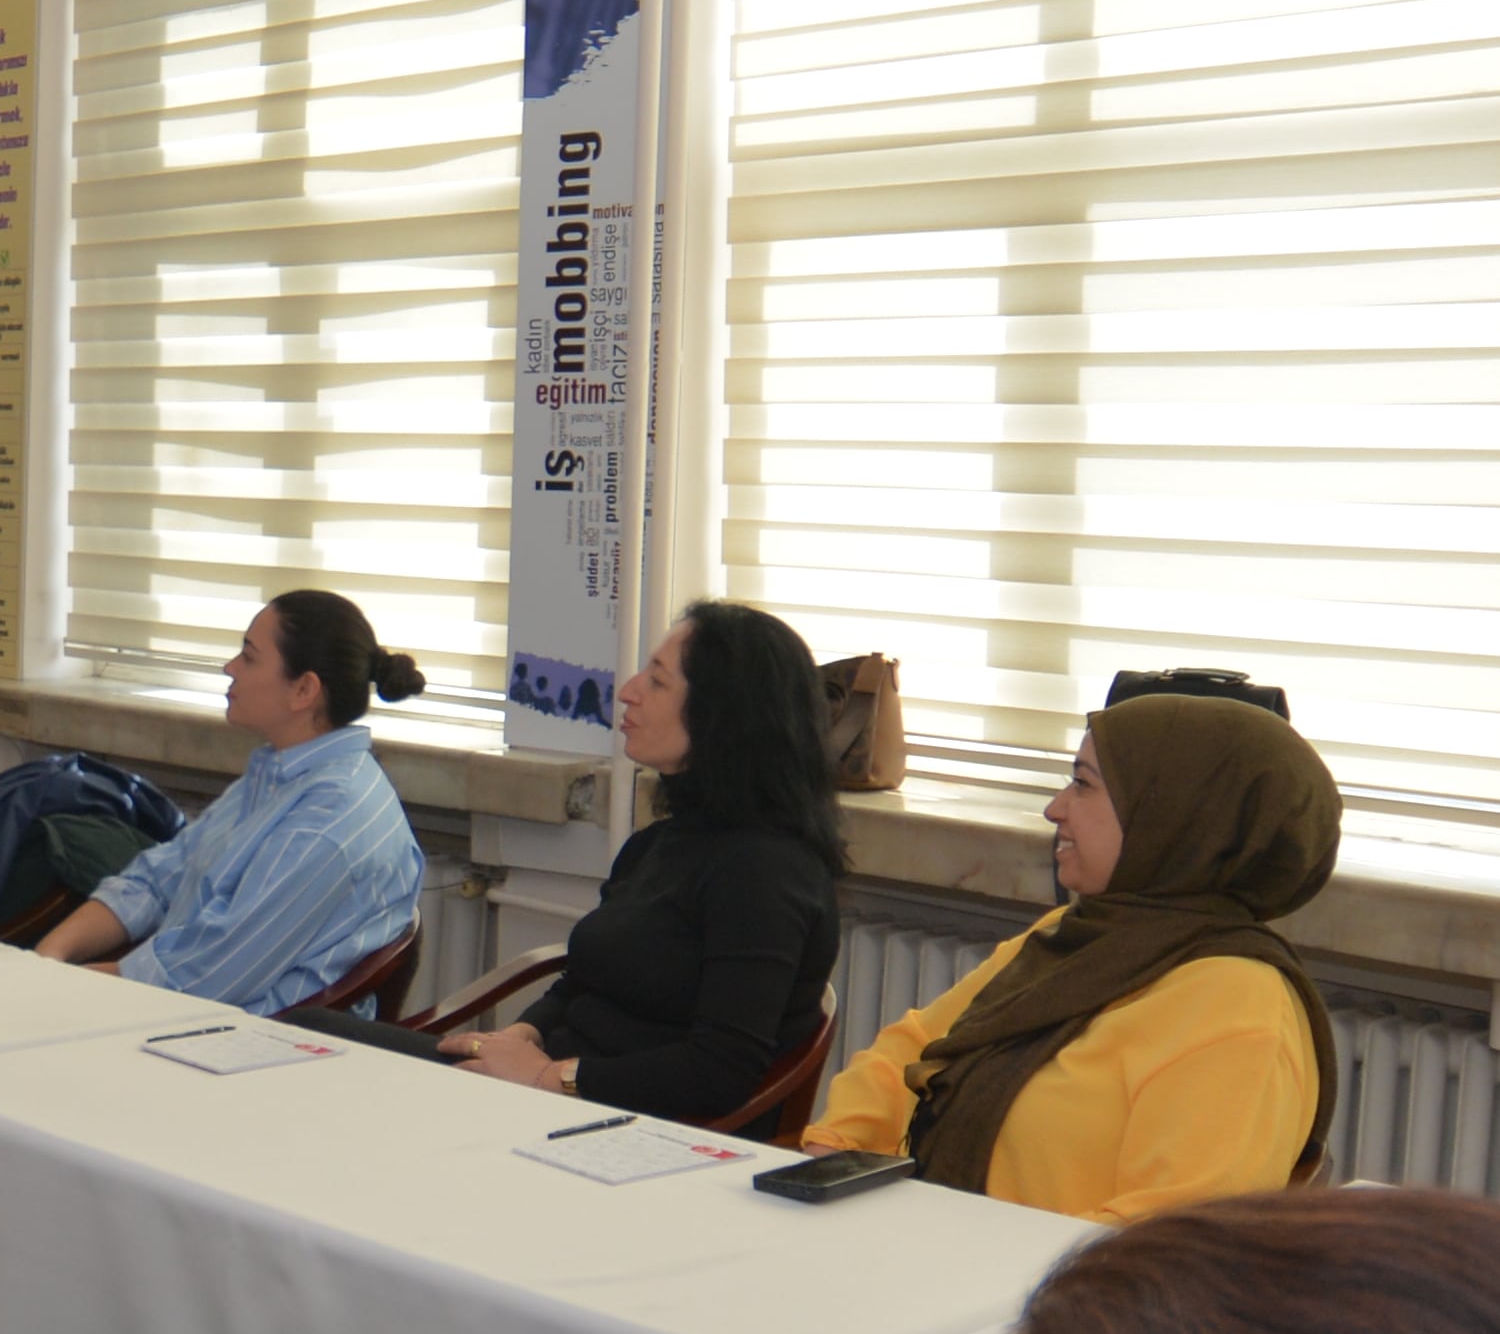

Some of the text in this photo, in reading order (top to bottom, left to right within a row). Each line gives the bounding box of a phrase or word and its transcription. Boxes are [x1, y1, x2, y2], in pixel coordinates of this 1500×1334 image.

[545, 130, 602, 373] mobbing
[601, 223, 620, 282] endişe
[590, 286, 628, 306] saygı
[524, 318, 543, 375] kadın
[590, 310, 612, 343] işçi
[536, 375, 607, 410] eğitim
[535, 450, 584, 492] iş
[603, 451, 619, 523] problem
[586, 552, 600, 598] şiddet
